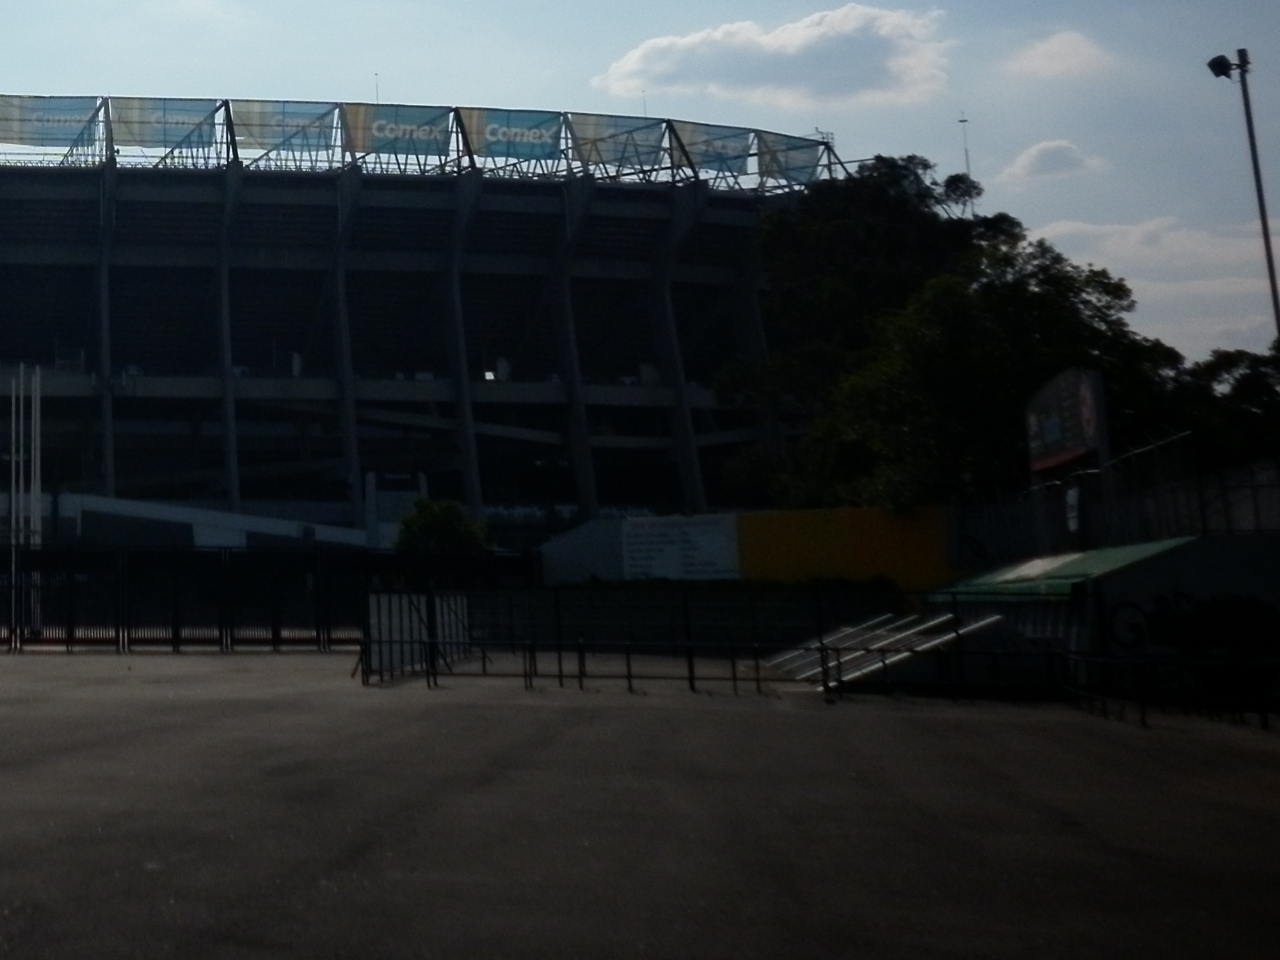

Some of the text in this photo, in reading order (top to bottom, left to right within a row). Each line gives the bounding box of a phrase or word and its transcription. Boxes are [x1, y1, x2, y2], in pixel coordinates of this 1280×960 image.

[152, 112, 211, 128] Come
[372, 120, 449, 140] Comex
[485, 123, 557, 143] Comex
